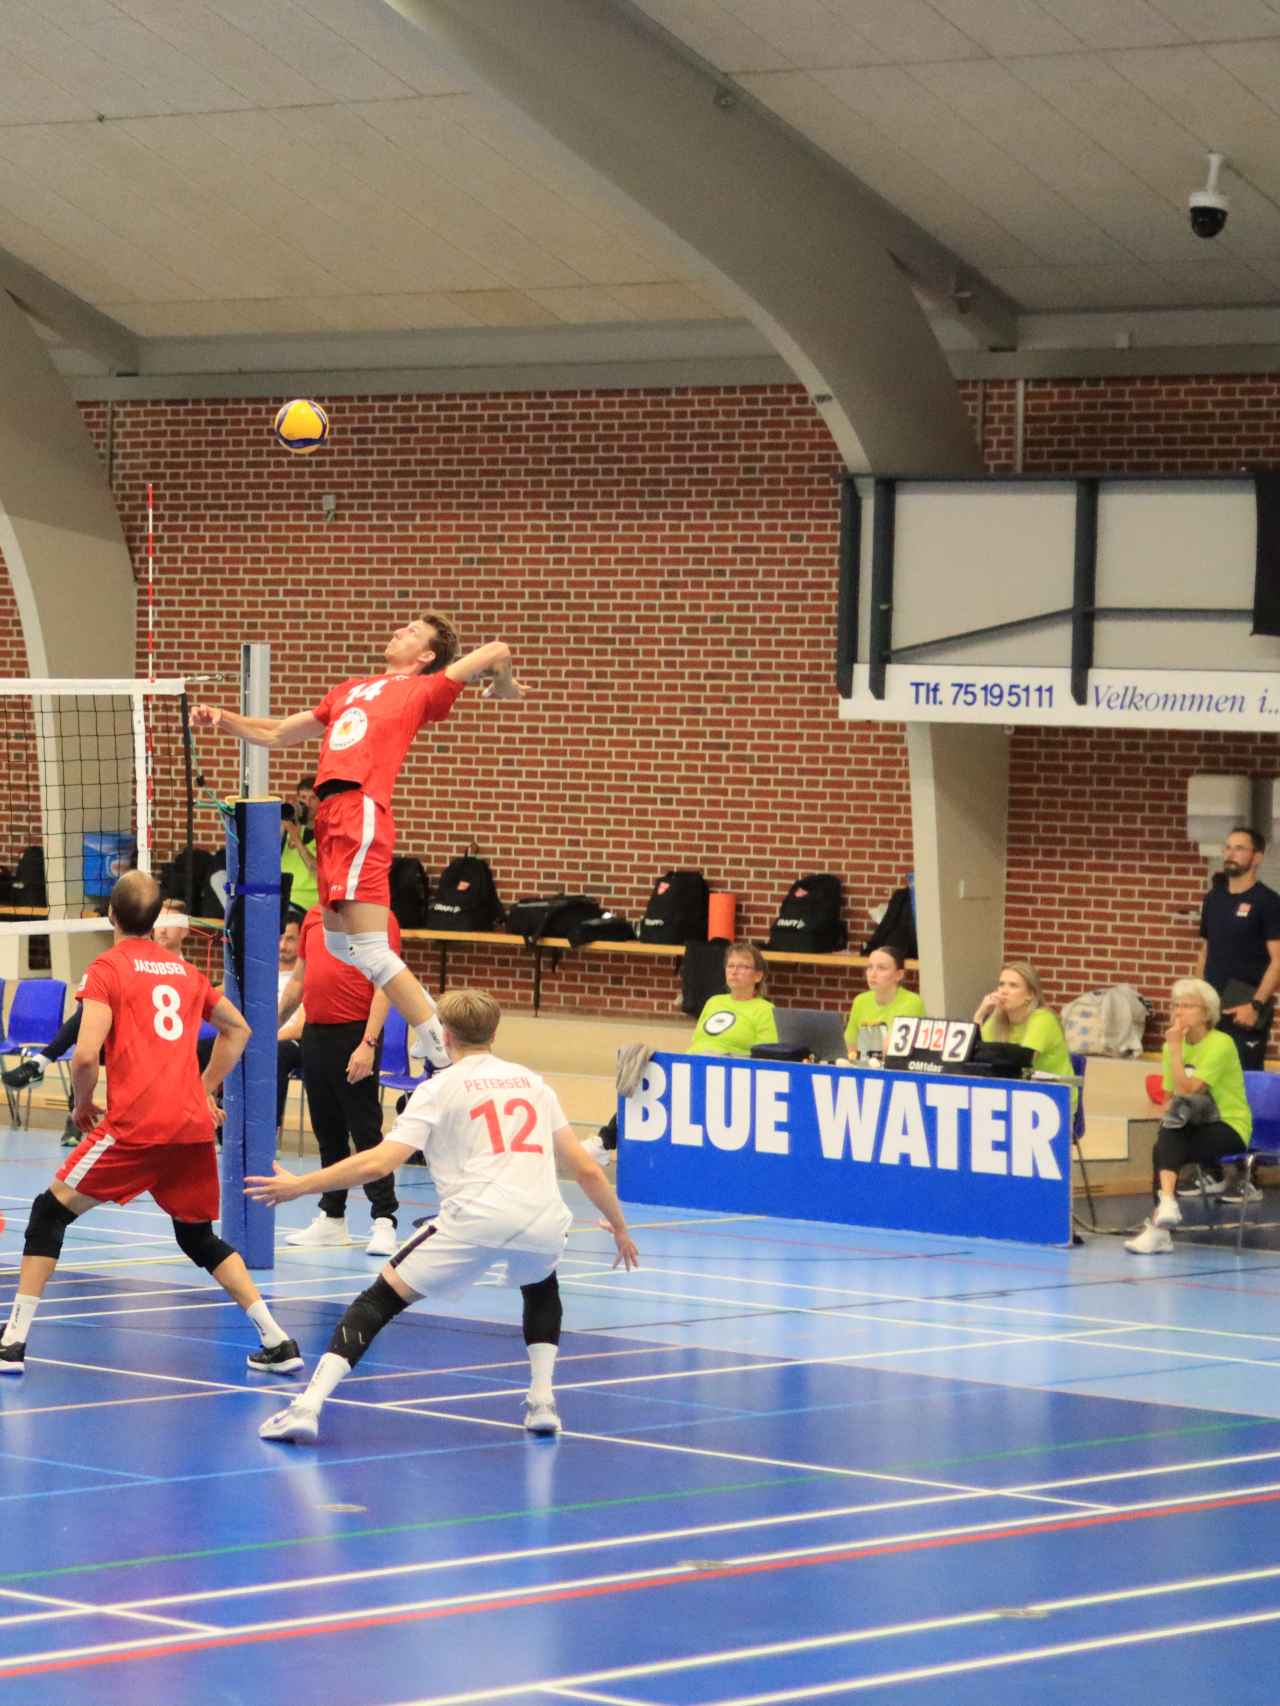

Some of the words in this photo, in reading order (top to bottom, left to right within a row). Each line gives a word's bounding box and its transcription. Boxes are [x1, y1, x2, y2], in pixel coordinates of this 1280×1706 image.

[910, 682, 943, 705] Tlf.
[1094, 685, 1246, 713] Velkommen
[152, 984, 183, 1041] 8
[894, 1024, 911, 1052] 3
[948, 1029, 967, 1058] 2
[464, 1077, 531, 1093] PETERSEN
[470, 1097, 544, 1155] 12
[624, 1061, 790, 1155] BLUE
[811, 1073, 1063, 1181] WATER
